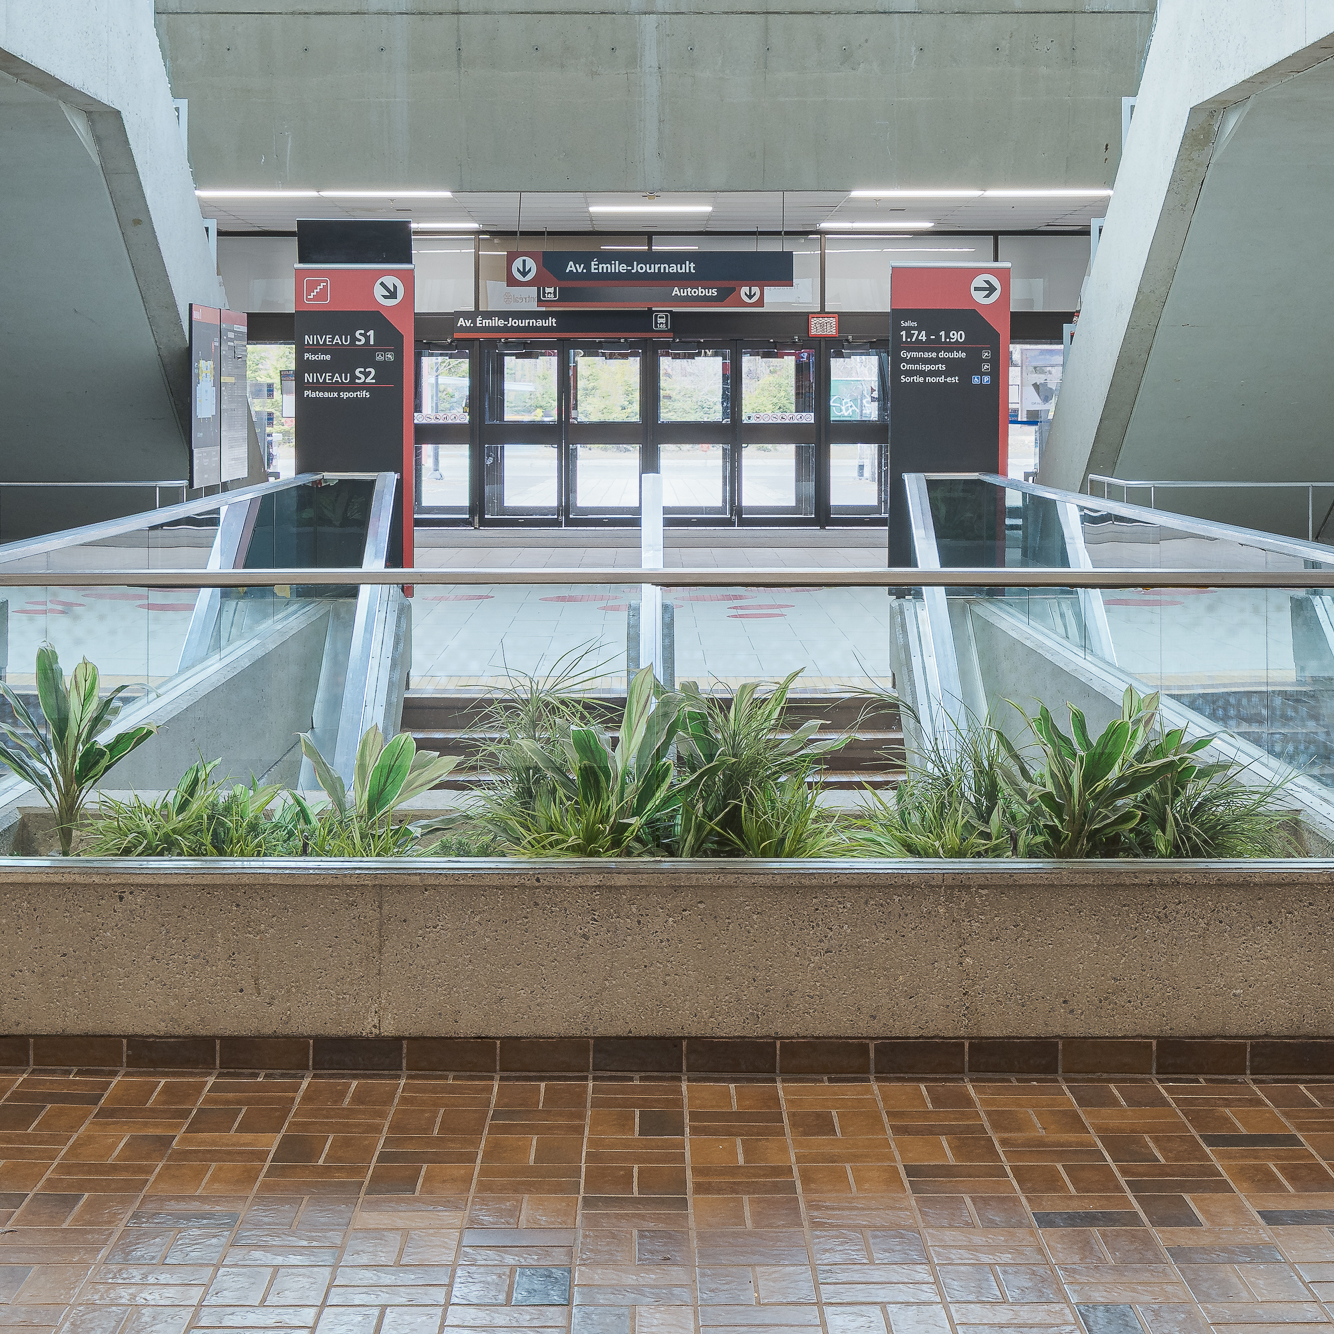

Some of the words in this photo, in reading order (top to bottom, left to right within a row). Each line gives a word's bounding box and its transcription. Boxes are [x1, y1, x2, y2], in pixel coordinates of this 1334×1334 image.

[565, 261, 587, 273] Av.
[590, 258, 696, 273] Émile-Journault
[671, 287, 718, 297] Autobus
[457, 317, 474, 327] Av.
[476, 315, 557, 327] Émile-Journault
[304, 334, 351, 345] NIVEAU
[355, 329, 375, 345] S1
[900, 330, 927, 342] 1.74
[939, 330, 966, 342] 1.90
[303, 352, 332, 361] Piscine
[900, 350, 937, 359] Gymnase
[938, 350, 967, 359] double
[900, 362, 947, 371] Omnisports
[304, 372, 351, 383] NIVEAU
[354, 367, 376, 383] S2
[900, 374, 924, 383] Sortie
[926, 374, 960, 383] nord-est
[303, 389, 338, 398] Plateaux
[340, 389, 371, 400] sportifs
